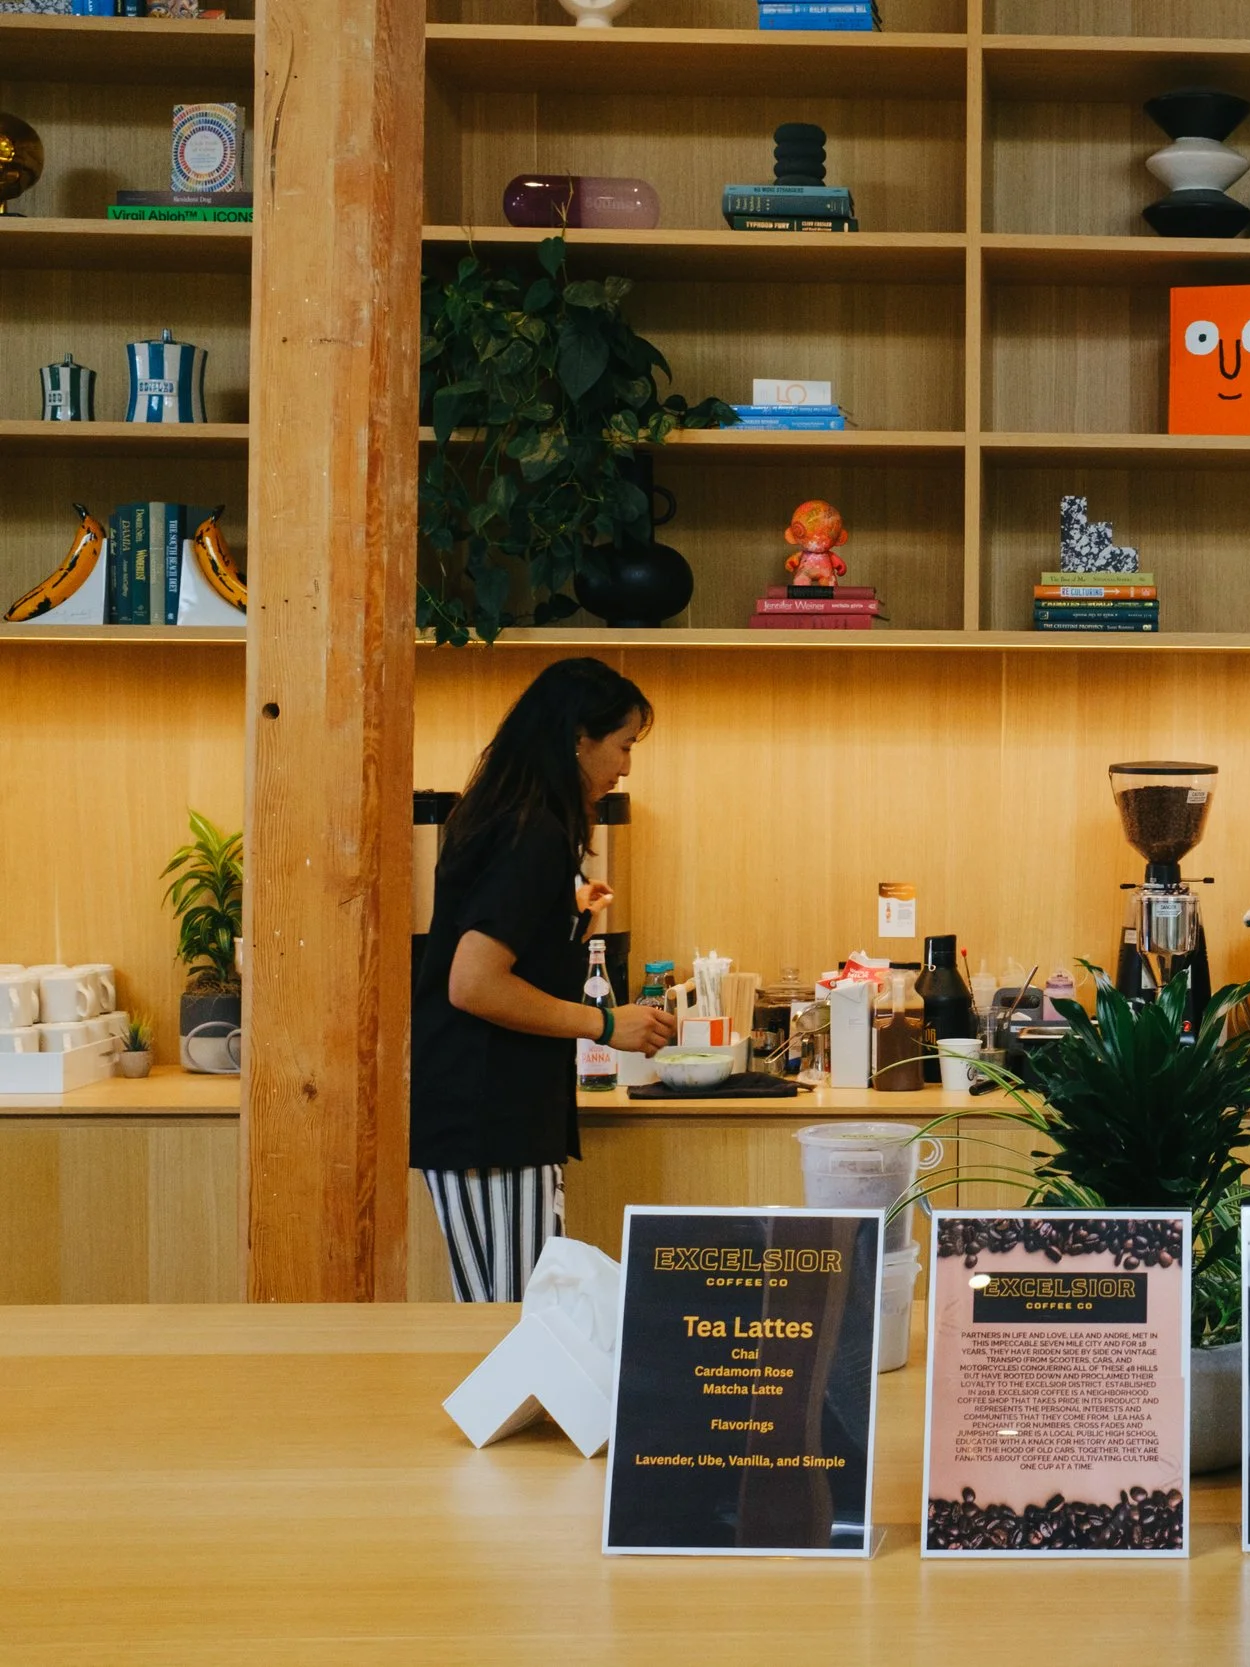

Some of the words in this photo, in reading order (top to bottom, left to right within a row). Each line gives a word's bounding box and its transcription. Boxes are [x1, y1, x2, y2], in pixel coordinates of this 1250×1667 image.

[113, 210, 144, 220] Virgil
[169, 520, 177, 533] THE
[122, 520, 130, 551] DAMIA
[169, 534, 177, 556] SOUTH
[169, 578, 177, 593] DIET
[764, 601, 792, 611] Jennifer
[795, 602, 825, 610] Weiner
[582, 1053, 610, 1063] PANNA
[654, 1247, 842, 1273] EXCELSIOR
[706, 1278, 762, 1287] COFFEE
[769, 1278, 788, 1287] CO
[984, 1278, 1135, 1297] EXCELSIOR
[684, 1316, 726, 1338] Tea
[734, 1316, 813, 1339] Lattes
[731, 1348, 759, 1360] Chai
[694, 1366, 761, 1378] Cardamom
[764, 1366, 794, 1378] Rose
[703, 1383, 749, 1395] Matcha
[752, 1384, 783, 1395] Latte
[711, 1419, 774, 1432] Flavorings
[635, 1454, 695, 1468] Lavender,
[698, 1455, 726, 1468] Ube,
[729, 1455, 774, 1468] Vanilla,
[777, 1455, 800, 1467] and
[803, 1455, 846, 1469] Simple
